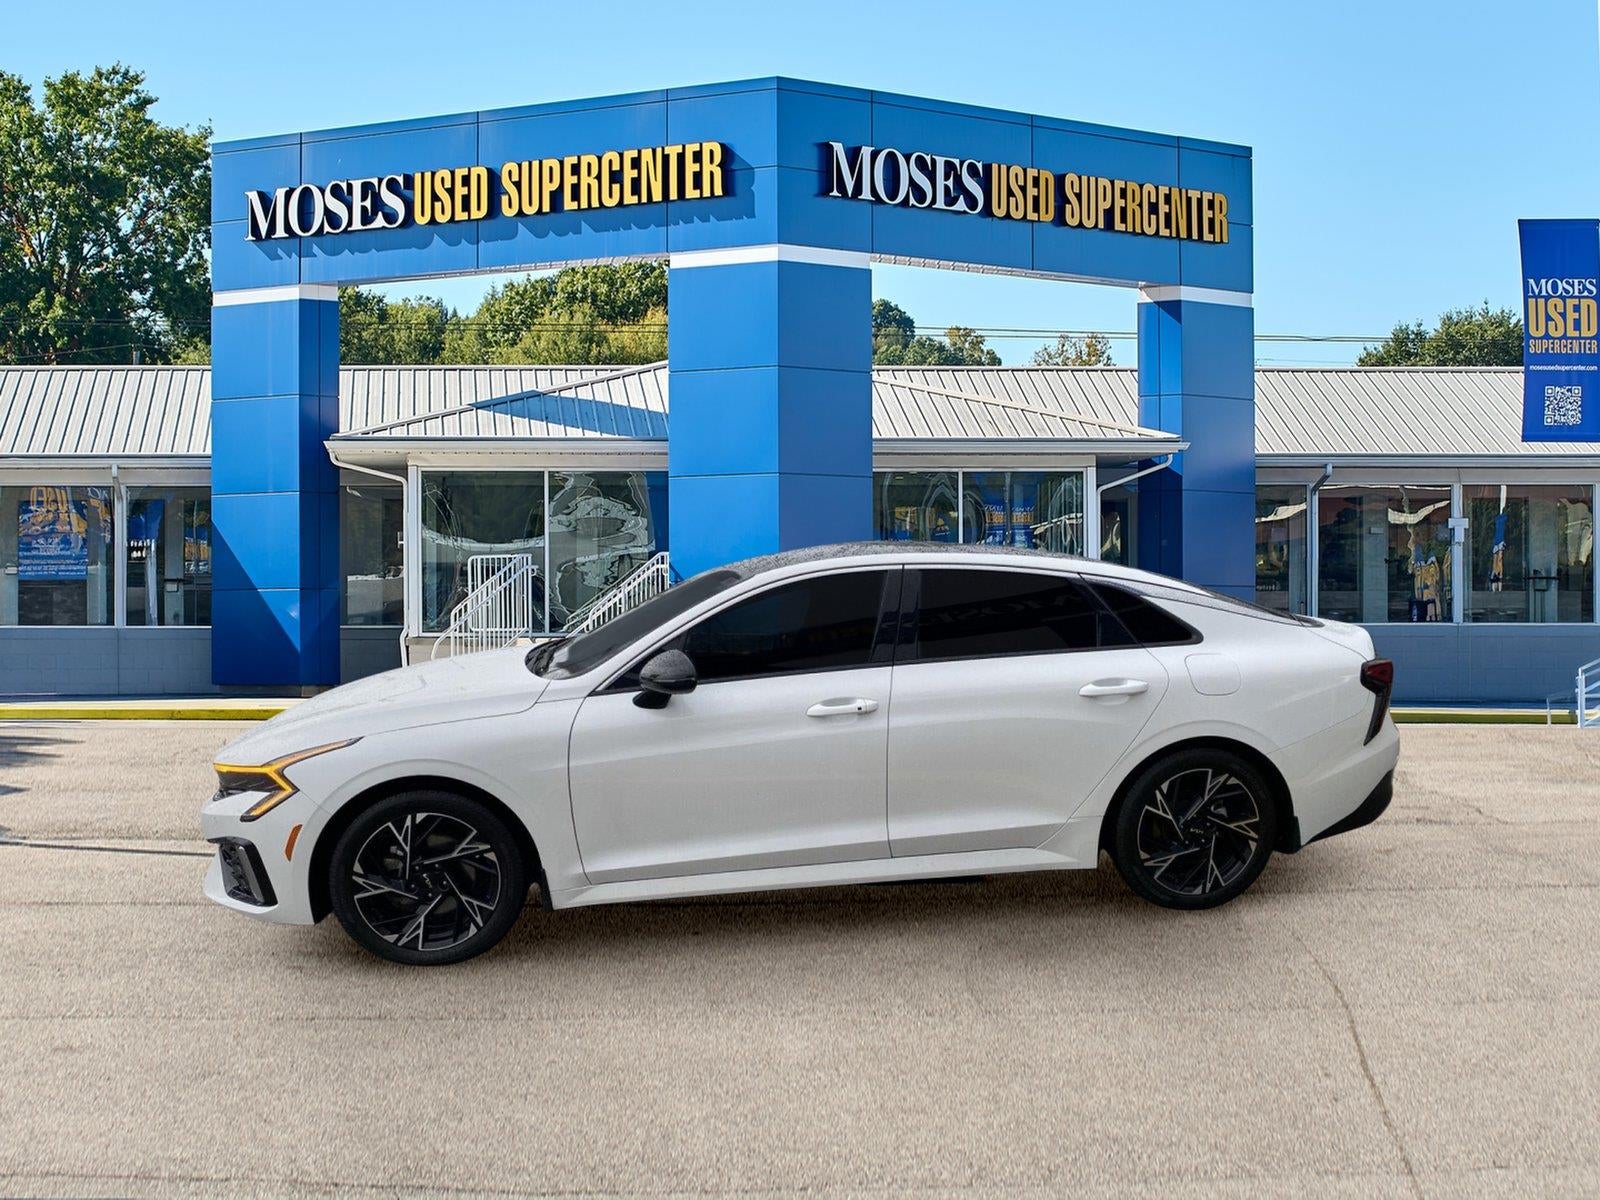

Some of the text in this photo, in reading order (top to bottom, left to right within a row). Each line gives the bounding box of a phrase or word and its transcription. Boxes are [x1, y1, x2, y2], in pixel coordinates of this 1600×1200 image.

[245, 141, 724, 241] MOSES USED SUPERCENTER
[828, 141, 1229, 244] MOSES USED SUPERCENTER
[1527, 278, 1597, 297] MOSES
[1528, 298, 1598, 338] USED
[1529, 339, 1598, 354] SUPERCENTER
